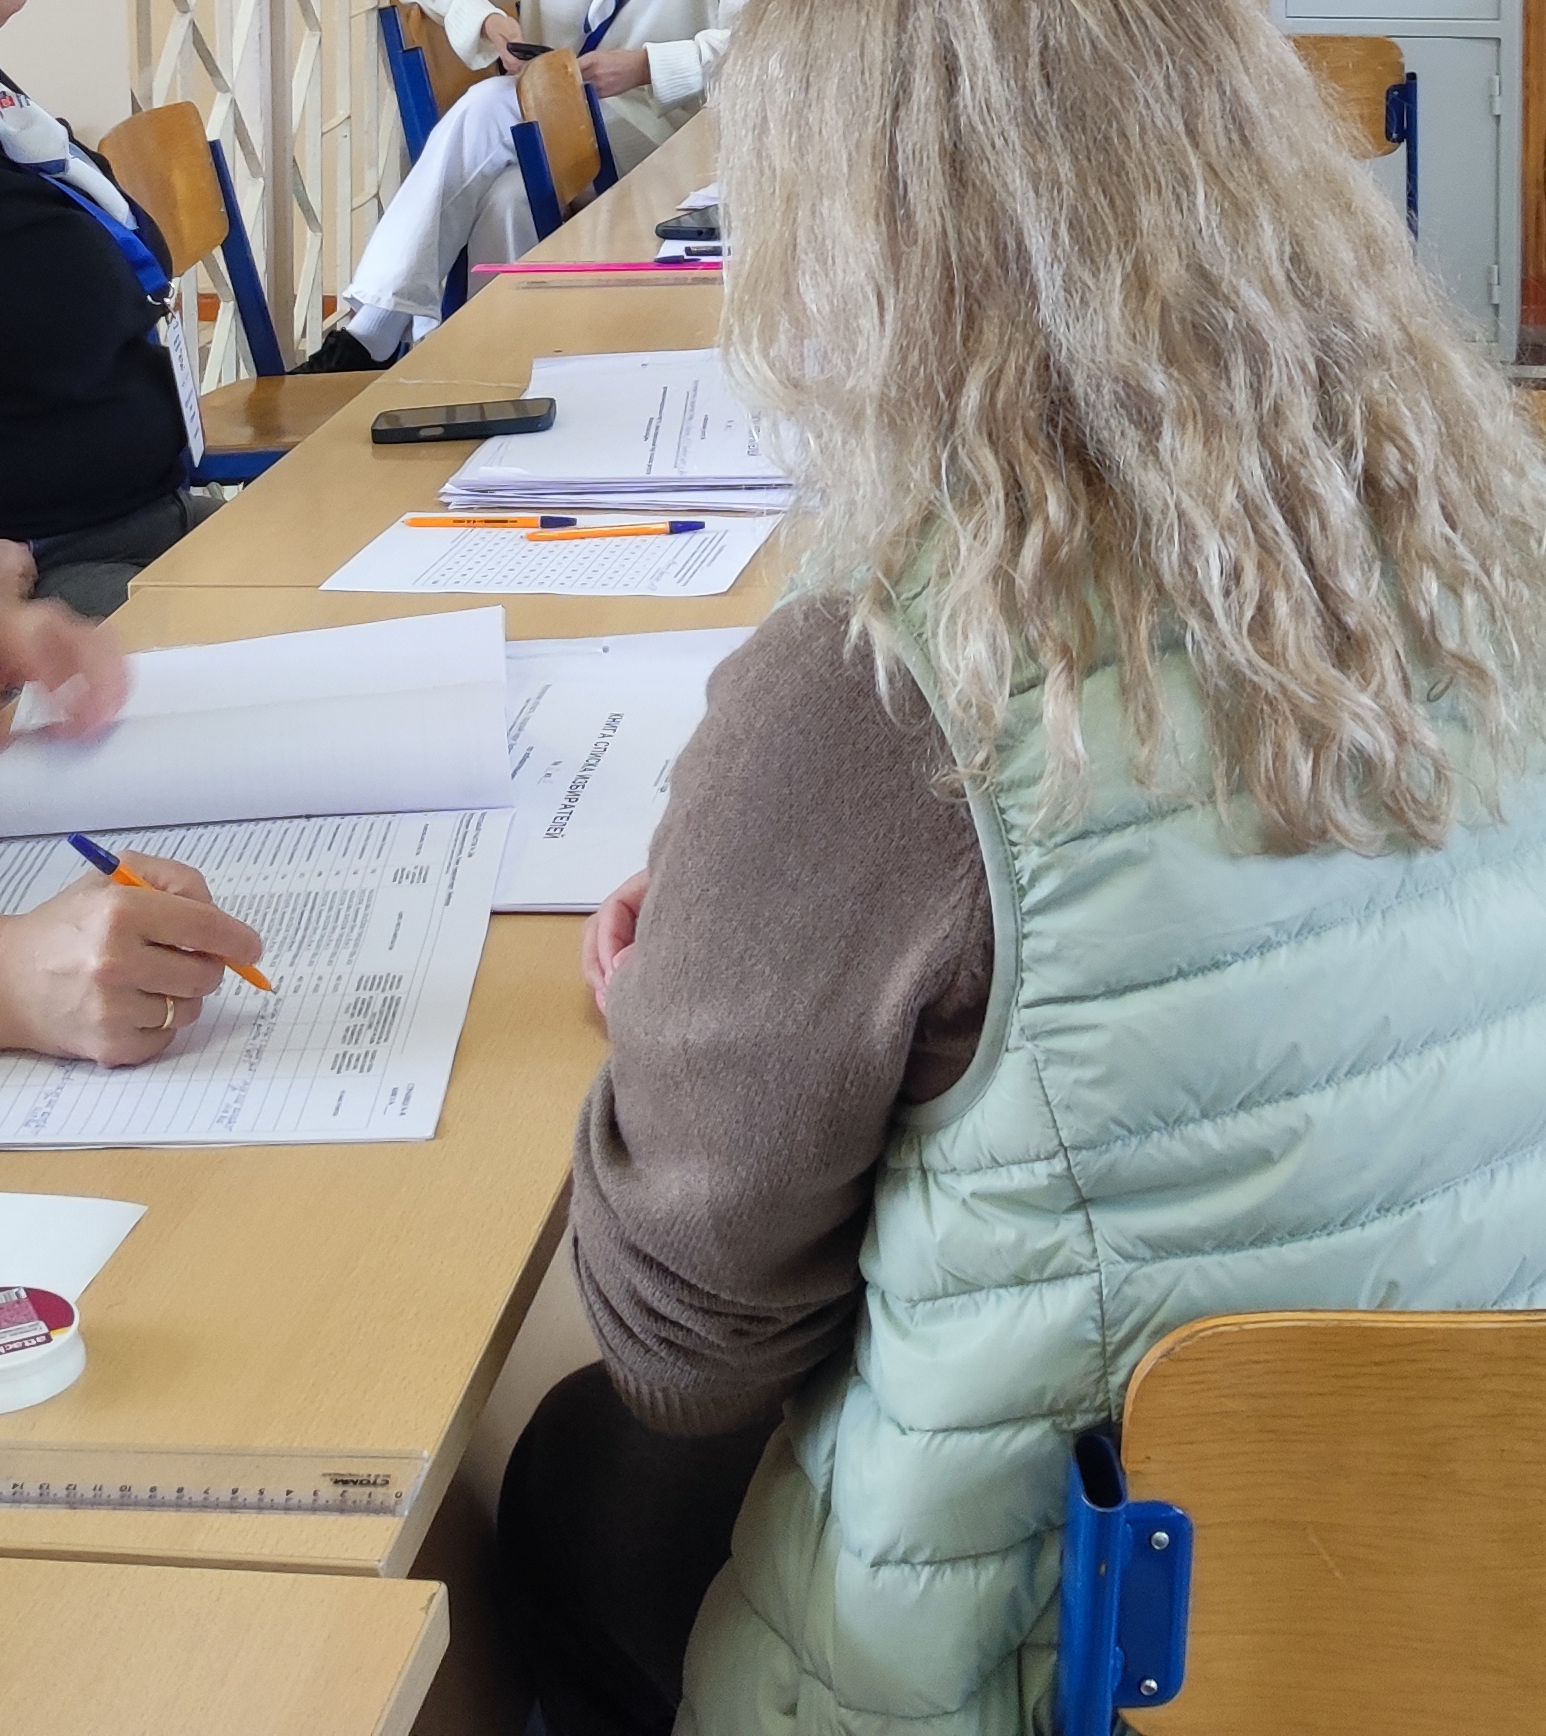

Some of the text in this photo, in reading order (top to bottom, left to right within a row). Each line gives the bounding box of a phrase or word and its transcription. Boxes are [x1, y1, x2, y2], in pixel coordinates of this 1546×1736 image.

[543, 712, 625, 839] КНИГА СПИСКА ИЗБИРАТЕЛЕЙ
[11, 1482, 24, 1490] 14
[38, 1482, 50, 1490] 13
[65, 1483, 77, 1491] 12
[92, 1484, 103, 1492] 11
